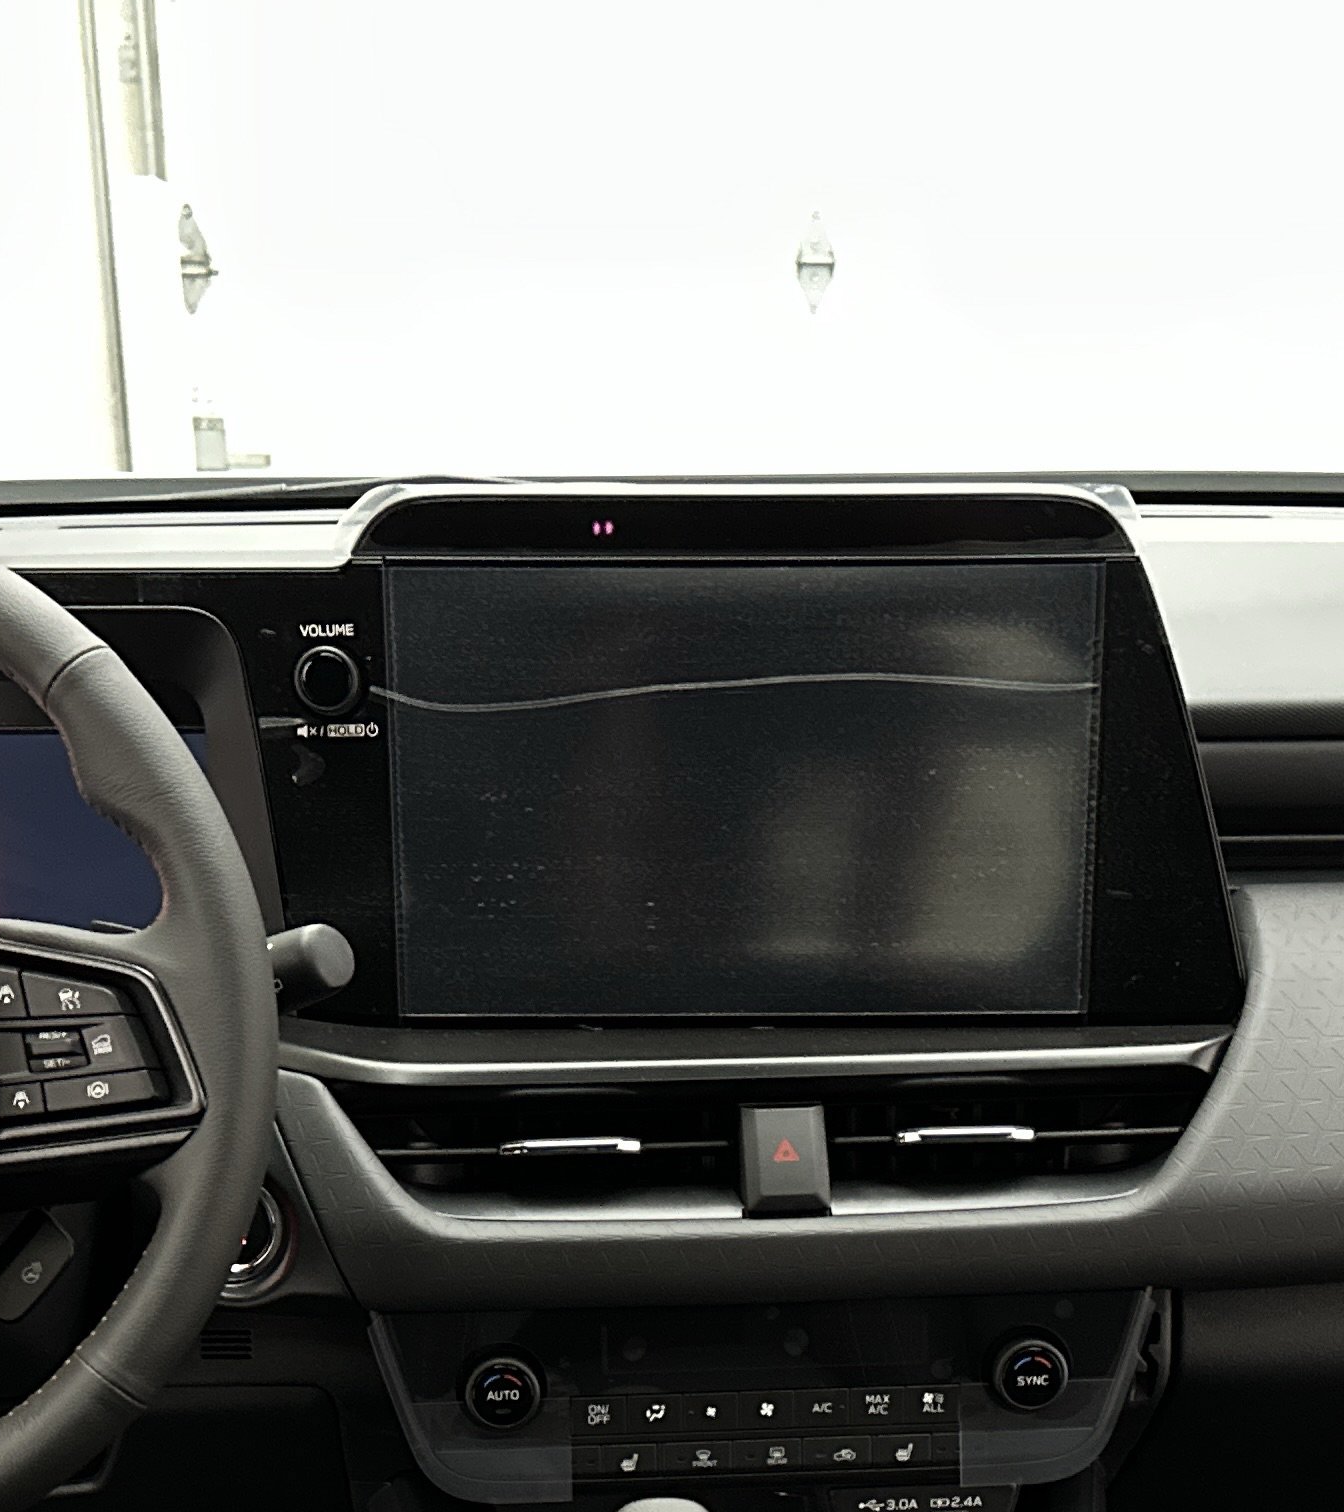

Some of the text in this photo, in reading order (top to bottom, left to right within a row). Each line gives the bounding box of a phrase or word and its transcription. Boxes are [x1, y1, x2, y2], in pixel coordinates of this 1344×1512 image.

[299, 623, 355, 638] VOLUME
[327, 723, 365, 737] HOLD
[1016, 1374, 1049, 1387] SYNC
[487, 1389, 519, 1402] AUTO
[865, 1394, 890, 1405] MAX
[812, 1403, 833, 1413] A/C
[868, 1404, 888, 1415] A/C
[922, 1403, 944, 1413] ALL
[587, 1414, 611, 1425] OFF
[886, 1499, 919, 1511] 3.0A
[951, 1496, 983, 1508] 2.4A
